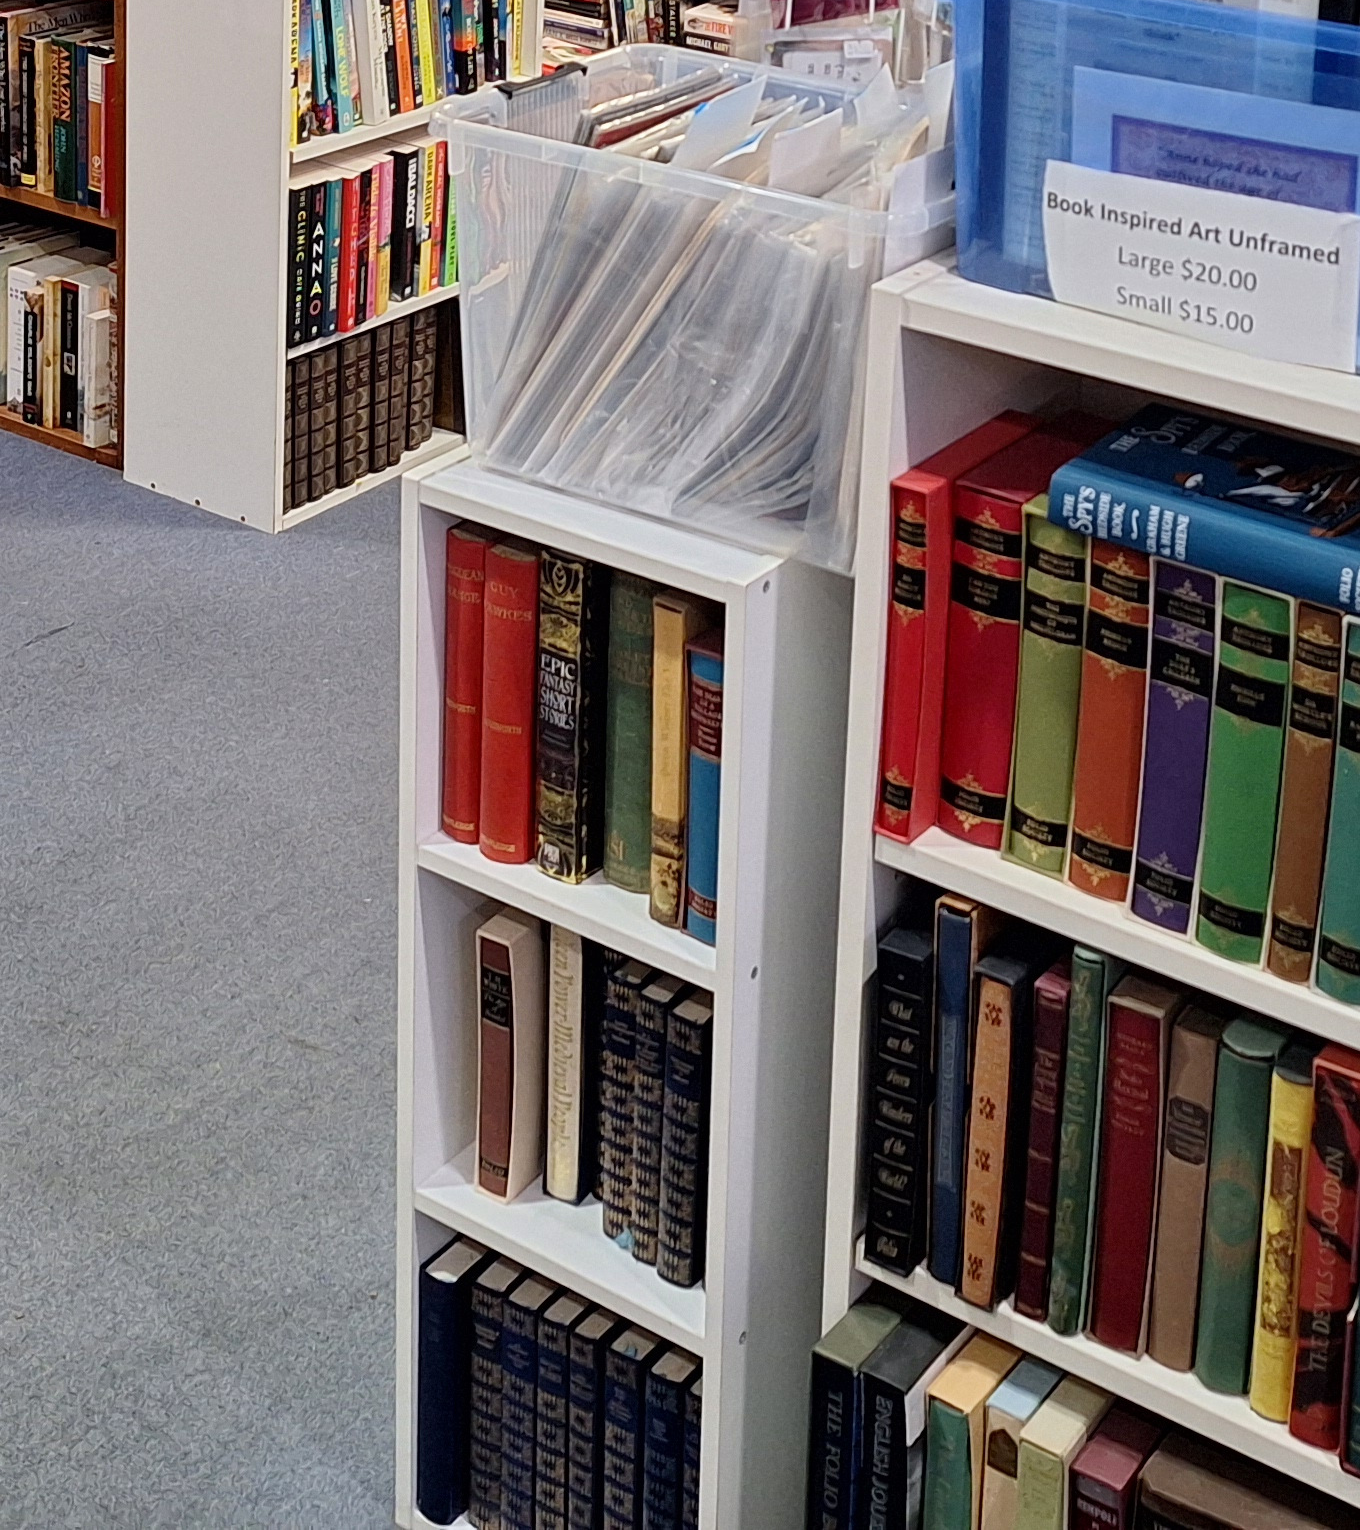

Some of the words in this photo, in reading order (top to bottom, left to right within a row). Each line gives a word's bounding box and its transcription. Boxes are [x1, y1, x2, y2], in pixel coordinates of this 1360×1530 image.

[1046, 190, 1092, 219] Book
[1100, 200, 1181, 240] Inspired
[1189, 218, 1221, 245] Art
[1228, 228, 1341, 265] Unframed
[1118, 246, 1174, 279] Large
[1181, 255, 1257, 294] $20.00
[1116, 286, 1171, 317] Small
[1179, 296, 1254, 335] $15.00
[1063, 492, 1075, 516] THE
[1099, 492, 1111, 540] BEDSIDE
[1112, 502, 1125, 538] BOOK
[1147, 505, 1161, 554] GRAHAM
[1161, 510, 1175, 543] HUGH
[1175, 515, 1189, 561] GREENE
[1161, 545, 1173, 556] &
[1340, 567, 1354, 604] FOLIO
[541, 654, 575, 679] EPIC
[541, 673, 575, 695] FANTASY
[541, 689, 575, 714] SHORT
[541, 709, 574, 731] STORIES
[1320, 1147, 1348, 1229] LOUDUN
[1320, 1236, 1338, 1266] OF
[1313, 1267, 1333, 1332] DEVILS
[1306, 1335, 1330, 1373] THE
